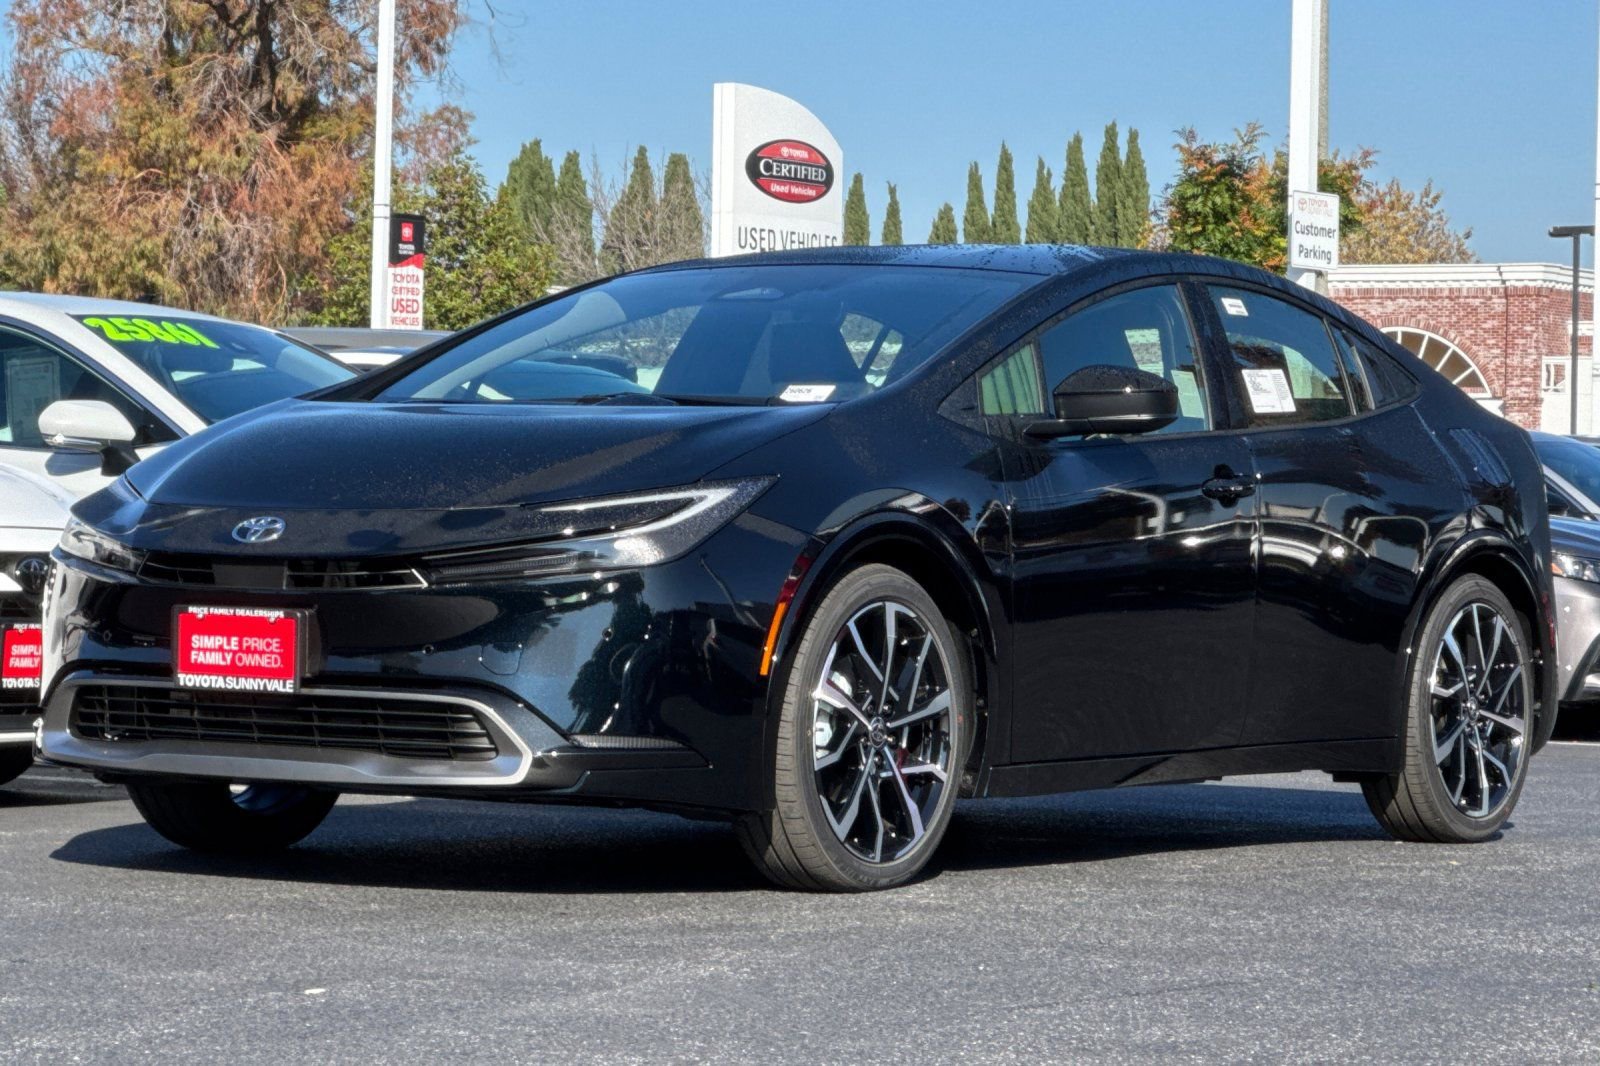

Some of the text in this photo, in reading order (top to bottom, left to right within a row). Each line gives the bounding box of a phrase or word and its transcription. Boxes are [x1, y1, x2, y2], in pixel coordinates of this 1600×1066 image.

[789, 148, 808, 158] TOYOTA
[760, 158, 826, 182] CERTIFIED
[770, 183, 816, 196] Used Vehicles
[1295, 220, 1336, 239] Customer
[738, 226, 775, 251] USED
[1299, 244, 1332, 264] Parking
[392, 273, 420, 283] TOYOTA
[391, 286, 420, 296] CERTIFIED
[391, 297, 419, 314] USED
[390, 315, 419, 326] VEHICLES
[188, 606, 285, 618] PRICE FAMILY DEALERSHIPS
[191, 634, 284, 652] SIMPLE PRICE.
[9, 657, 41, 668] FAMILY
[190, 650, 284, 668] FAMILY OWNED.
